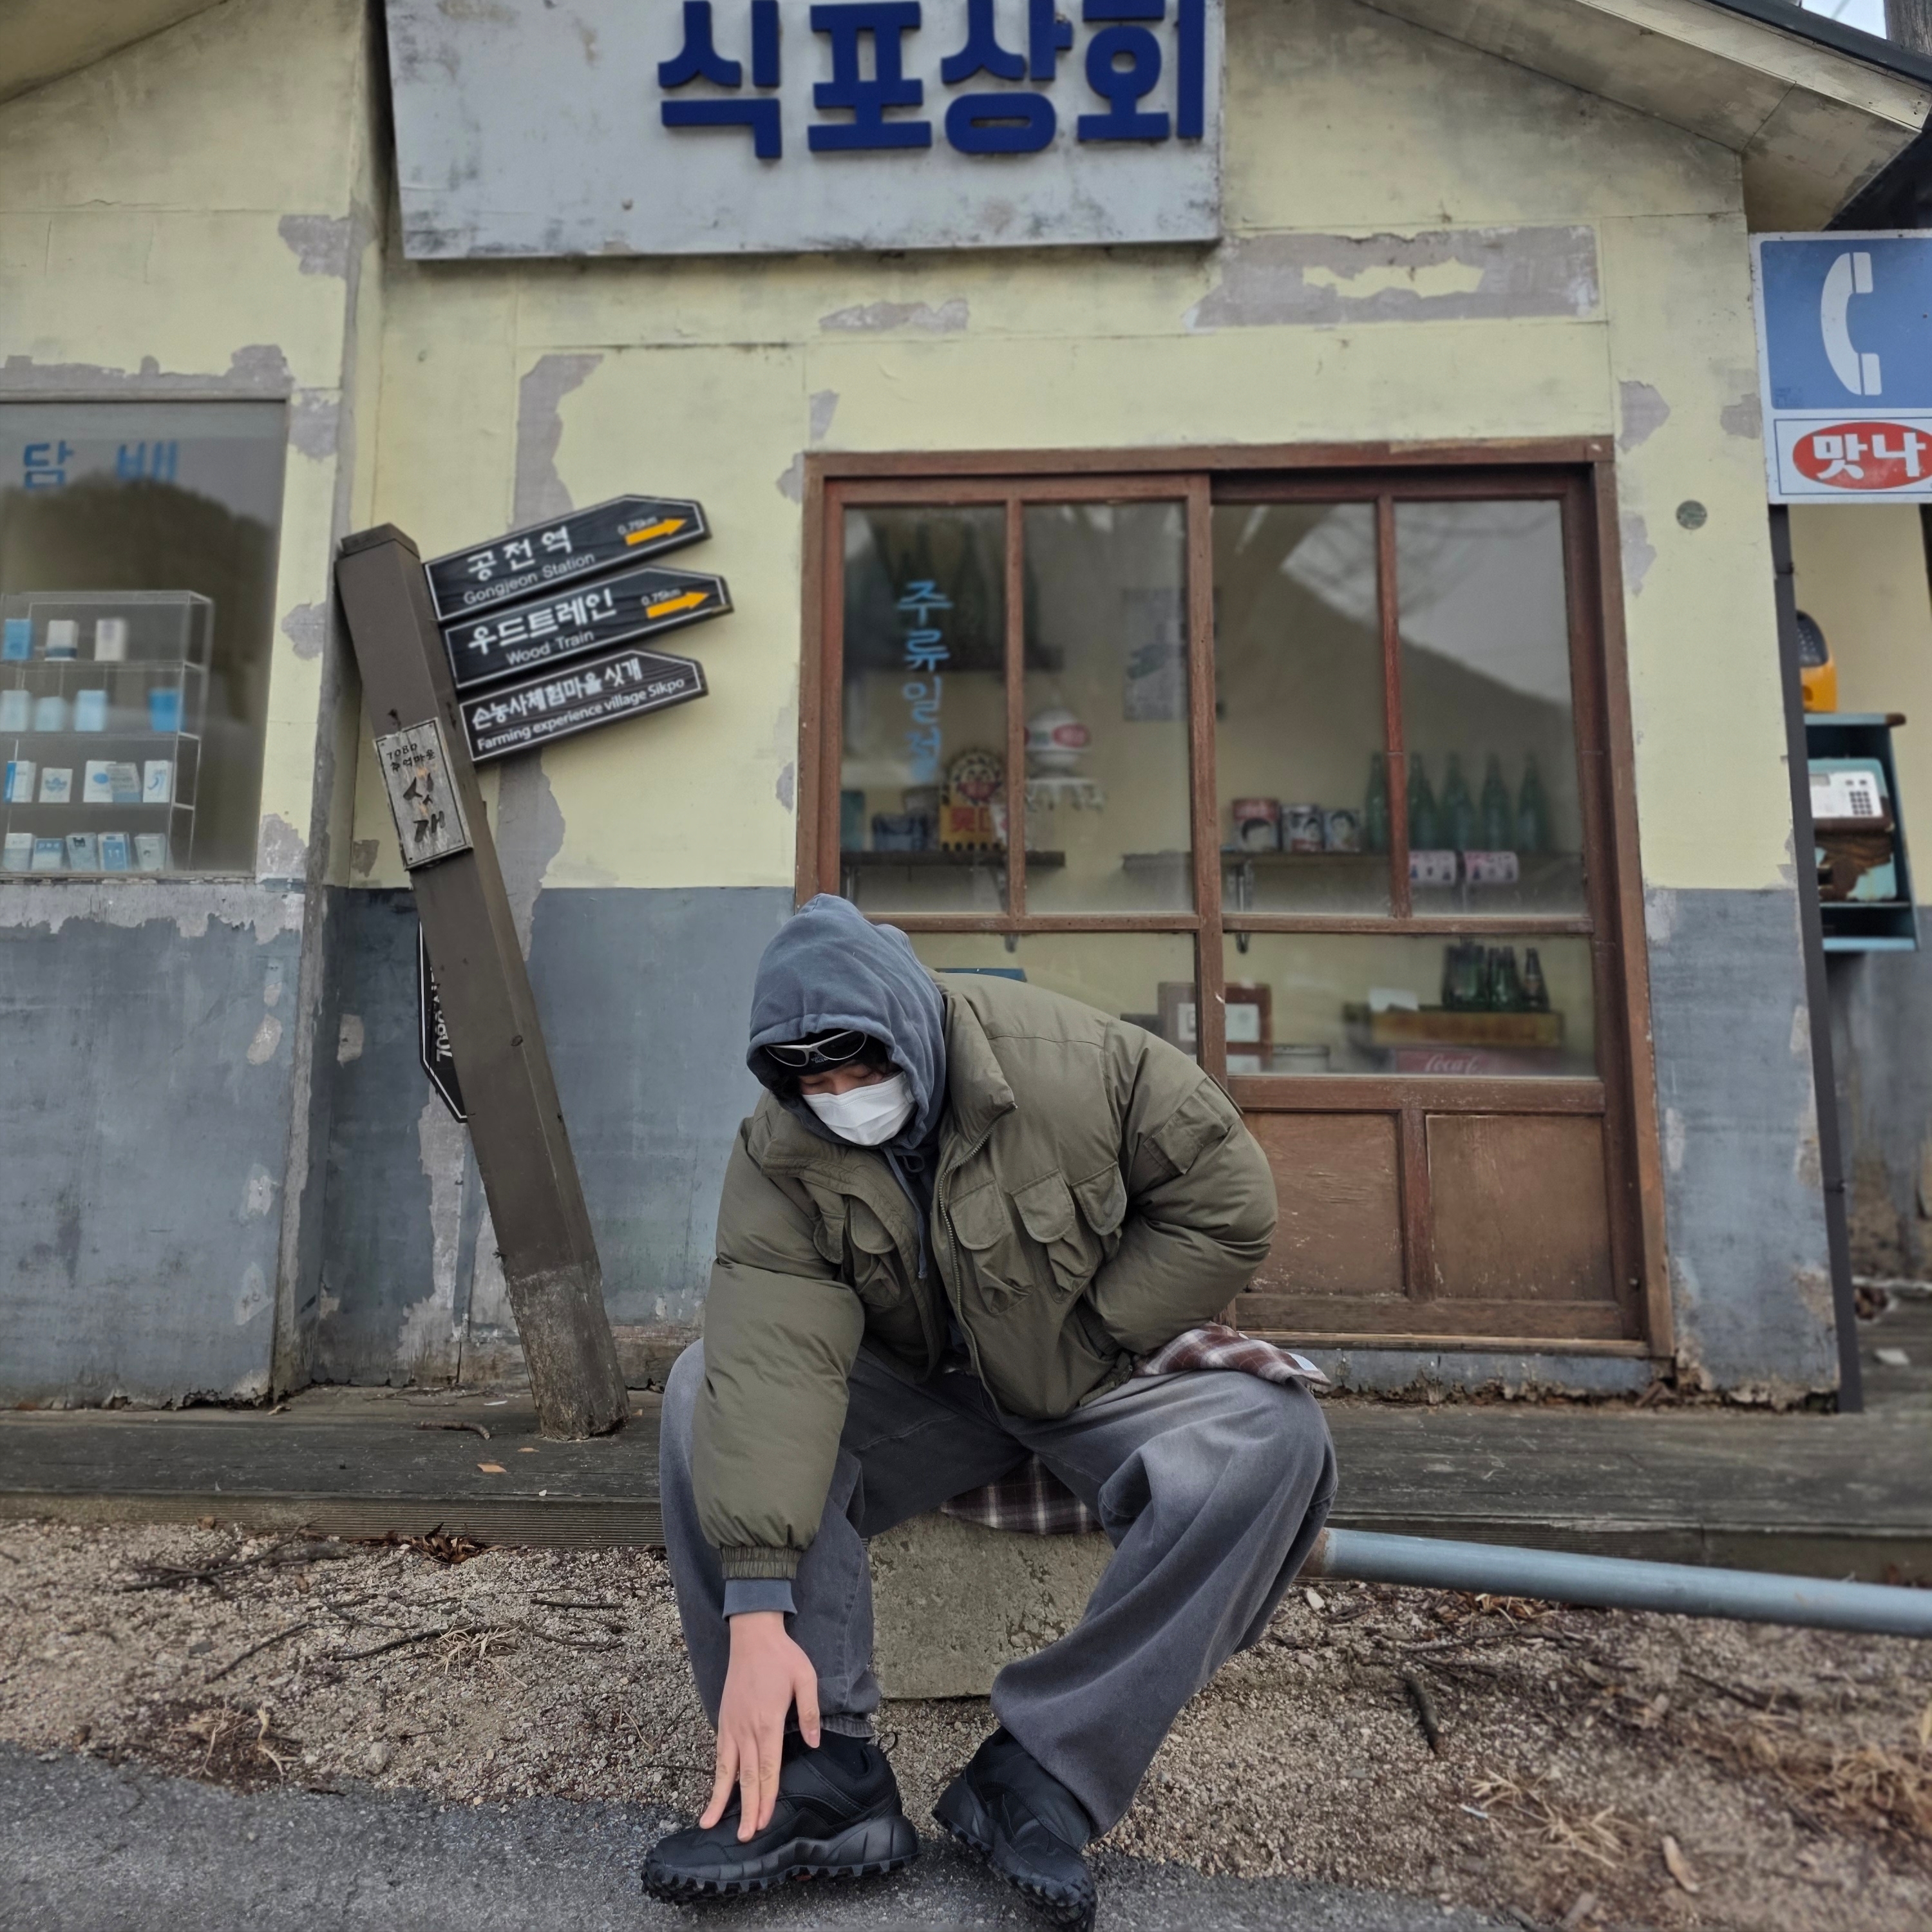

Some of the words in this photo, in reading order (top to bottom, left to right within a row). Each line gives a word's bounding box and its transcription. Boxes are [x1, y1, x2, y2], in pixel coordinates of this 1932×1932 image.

[658, 0, 1204, 160] 식포상회
[1812, 432, 1927, 480] 맛나
[464, 573, 538, 605] Gongjeon
[542, 553, 595, 578] Station
[468, 588, 617, 655] 우드트레인
[506, 641, 551, 665] Wood
[555, 630, 594, 650] Train
[604, 658, 643, 687] 싯개
[477, 726, 531, 751] Farming
[532, 706, 602, 732] experience
[603, 690, 647, 711] village
[647, 677, 685, 697] Sikpo
[386, 743, 418, 760] 7080
